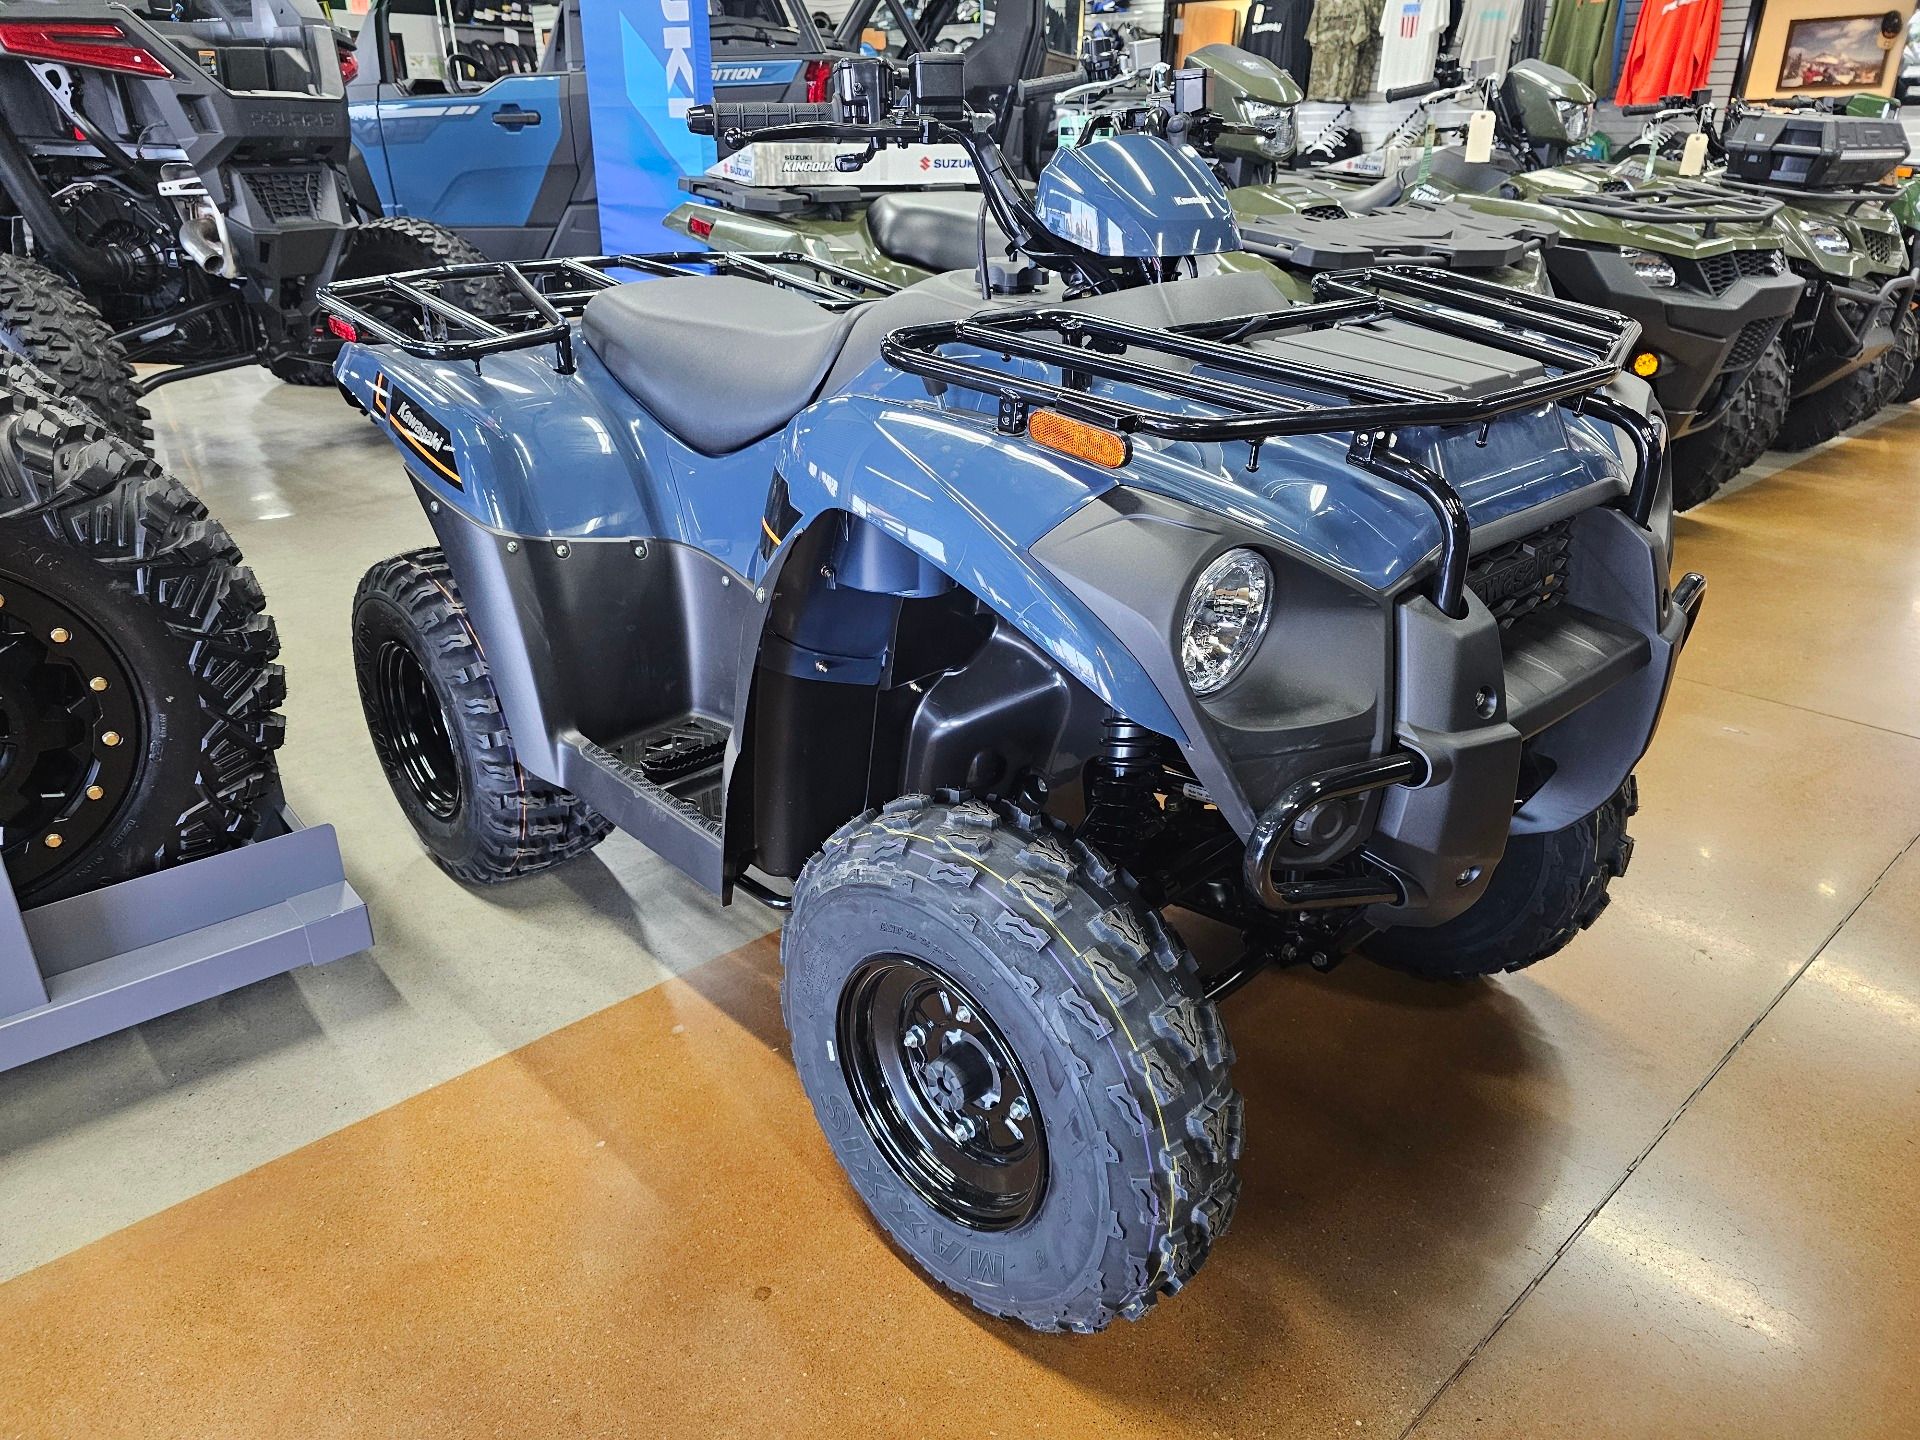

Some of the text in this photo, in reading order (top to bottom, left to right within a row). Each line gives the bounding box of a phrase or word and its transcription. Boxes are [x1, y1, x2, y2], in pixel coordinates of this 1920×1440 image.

[250, 111, 336, 127] POLARIS
[730, 165, 753, 179] SUZUKI
[781, 161, 839, 173] KINGQUA
[396, 401, 445, 453] Kawasaki
[1466, 545, 1555, 605] awasaki
[820, 1090, 1006, 1287] MAXXIS
